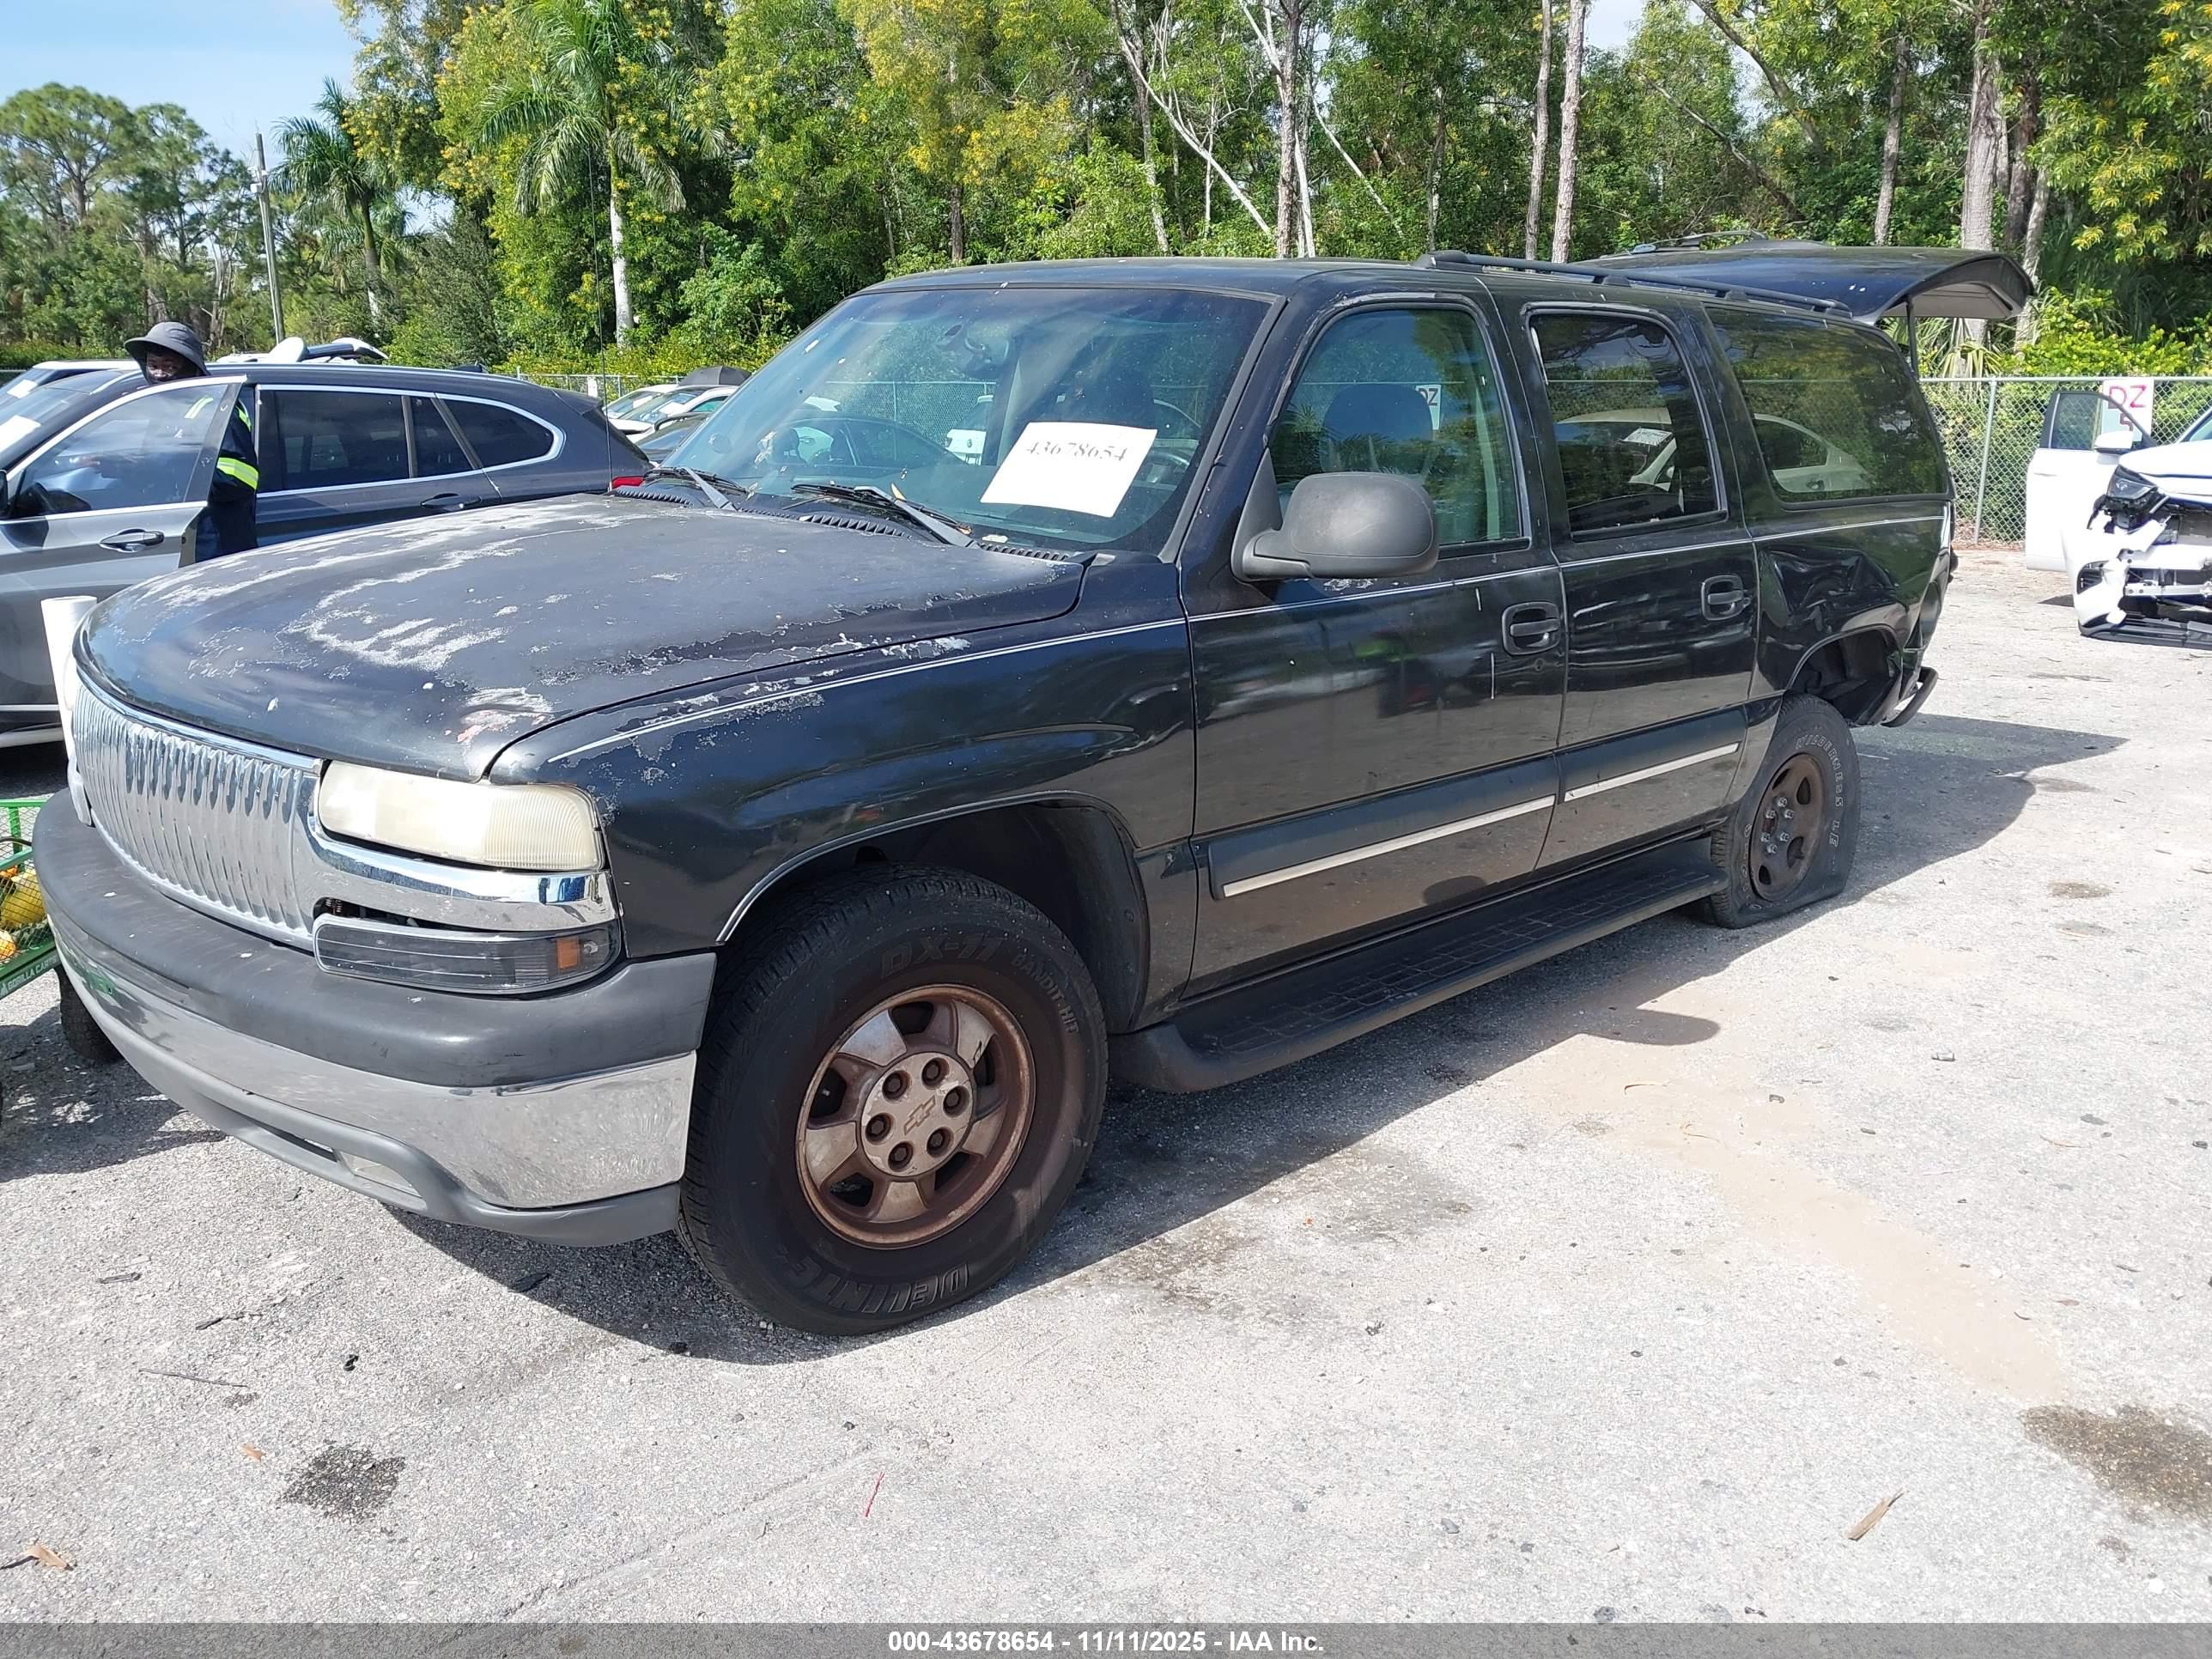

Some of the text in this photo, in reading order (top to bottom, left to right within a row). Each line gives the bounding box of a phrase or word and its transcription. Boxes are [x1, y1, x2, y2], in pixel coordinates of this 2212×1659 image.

[2107, 385, 2147, 410] DZ
[1025, 441, 1128, 461] 43678654
[1010, 953, 1066, 1003] BANDIT
